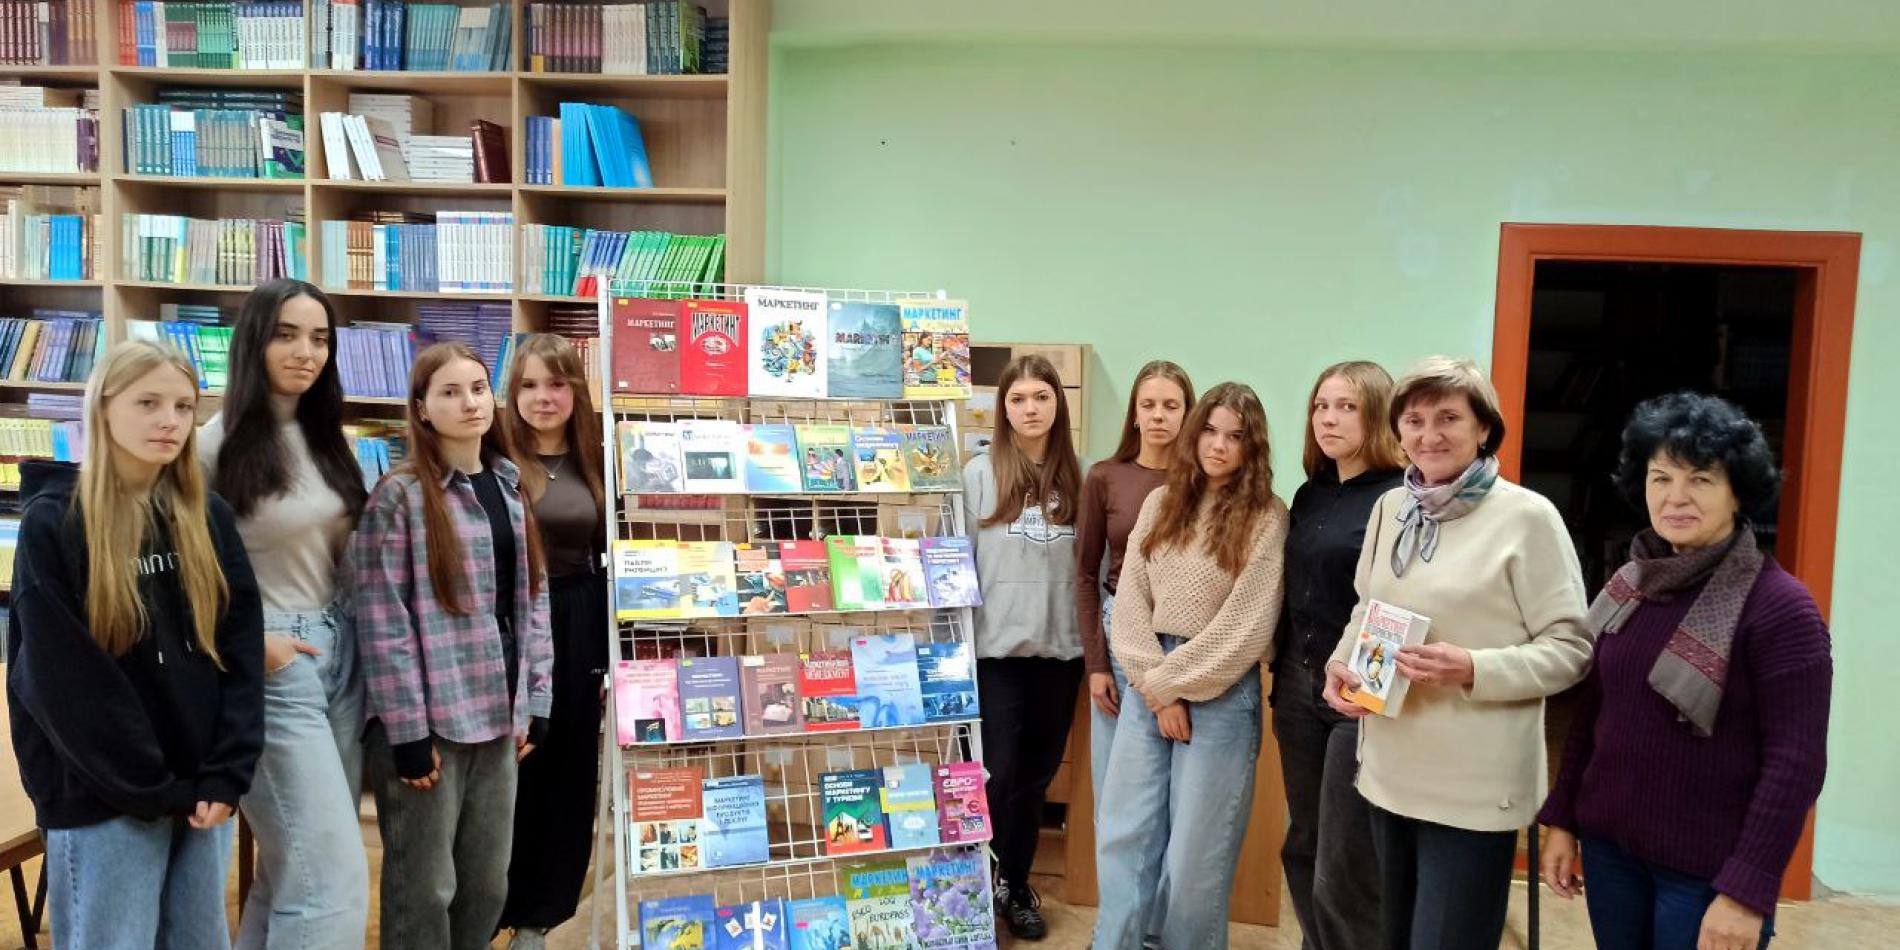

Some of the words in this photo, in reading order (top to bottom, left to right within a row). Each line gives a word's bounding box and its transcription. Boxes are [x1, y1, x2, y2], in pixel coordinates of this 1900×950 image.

[757, 297, 820, 311] МАРКЕТИНГ
[903, 307, 962, 321] МАРКЕТИНГ
[627, 317, 676, 329] МАРКЕТИНГ
[690, 311, 742, 347] МАРКЕТИНГ
[852, 868, 909, 886] МАРКЕТИН
